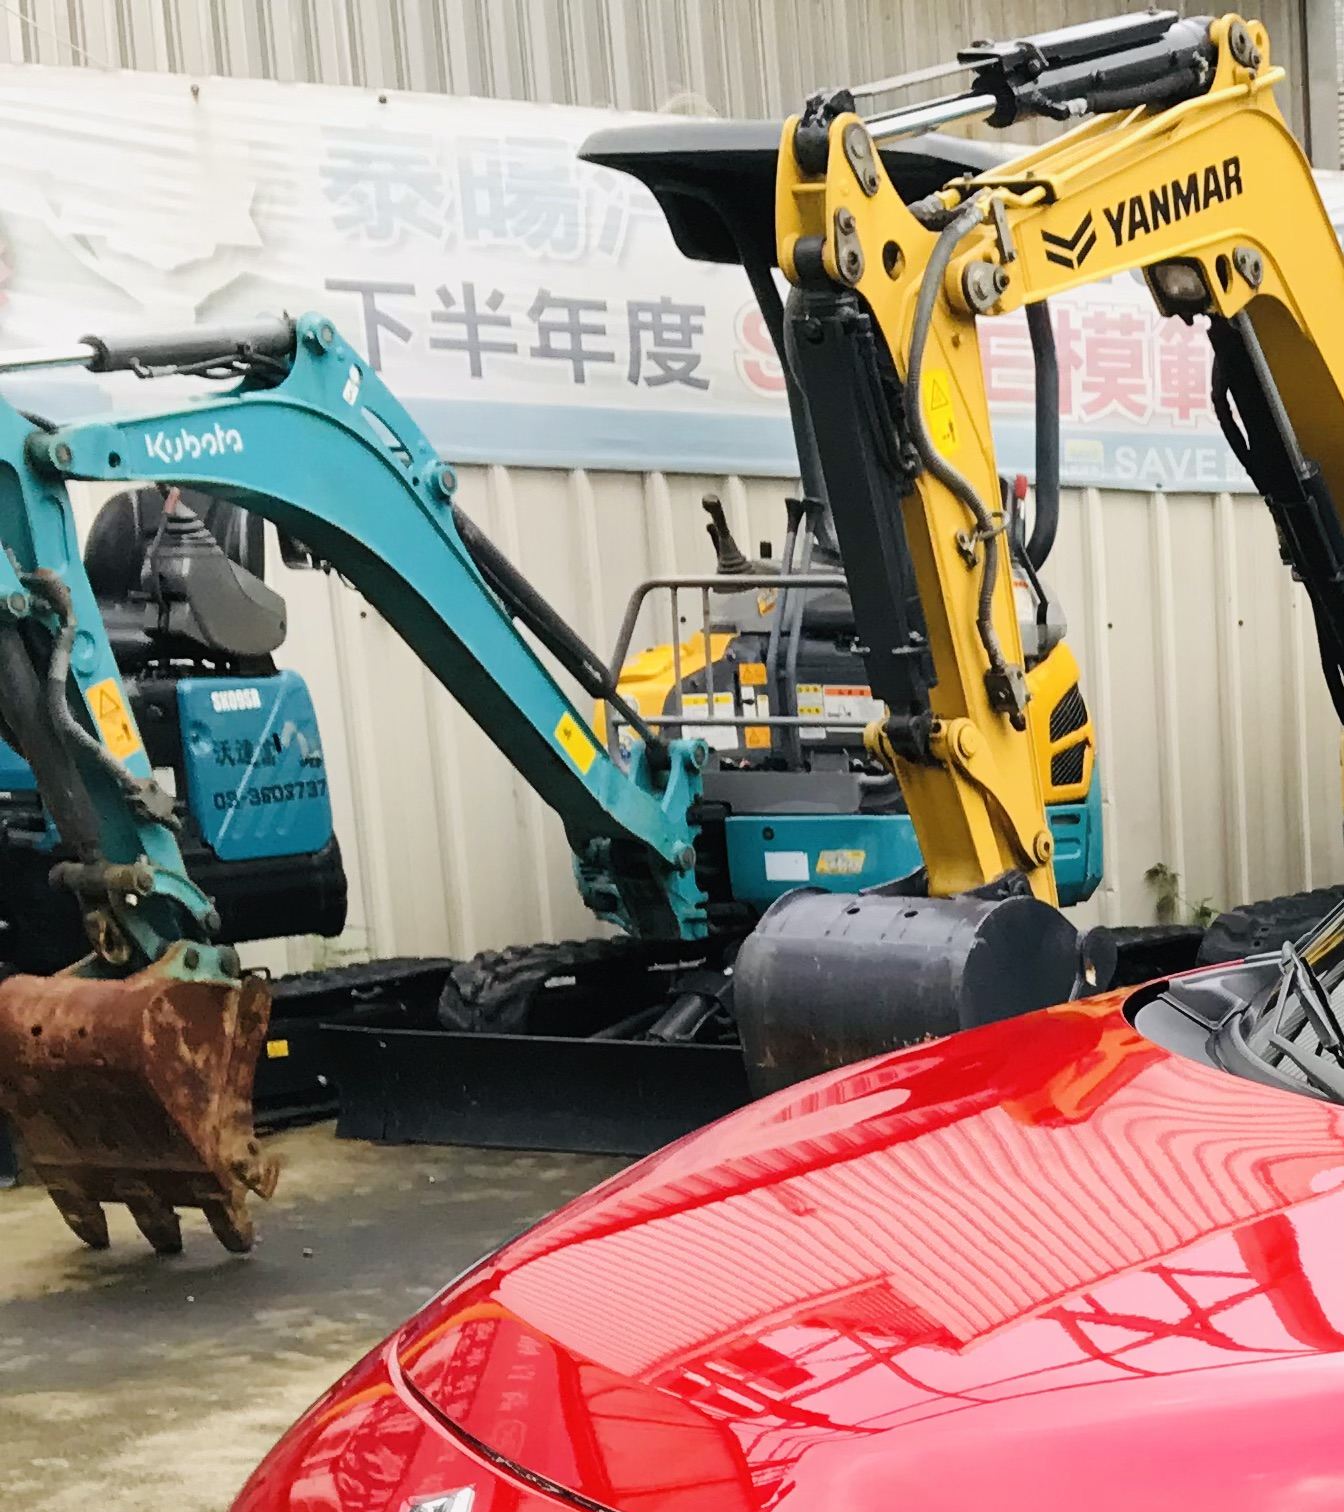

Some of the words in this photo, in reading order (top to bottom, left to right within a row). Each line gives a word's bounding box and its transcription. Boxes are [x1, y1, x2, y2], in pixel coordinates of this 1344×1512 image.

[1102, 156, 1244, 249] YANMAR
[324, 277, 711, 390] 下半年度
[144, 422, 244, 464] Kubota
[1115, 446, 1217, 481] SAVE
